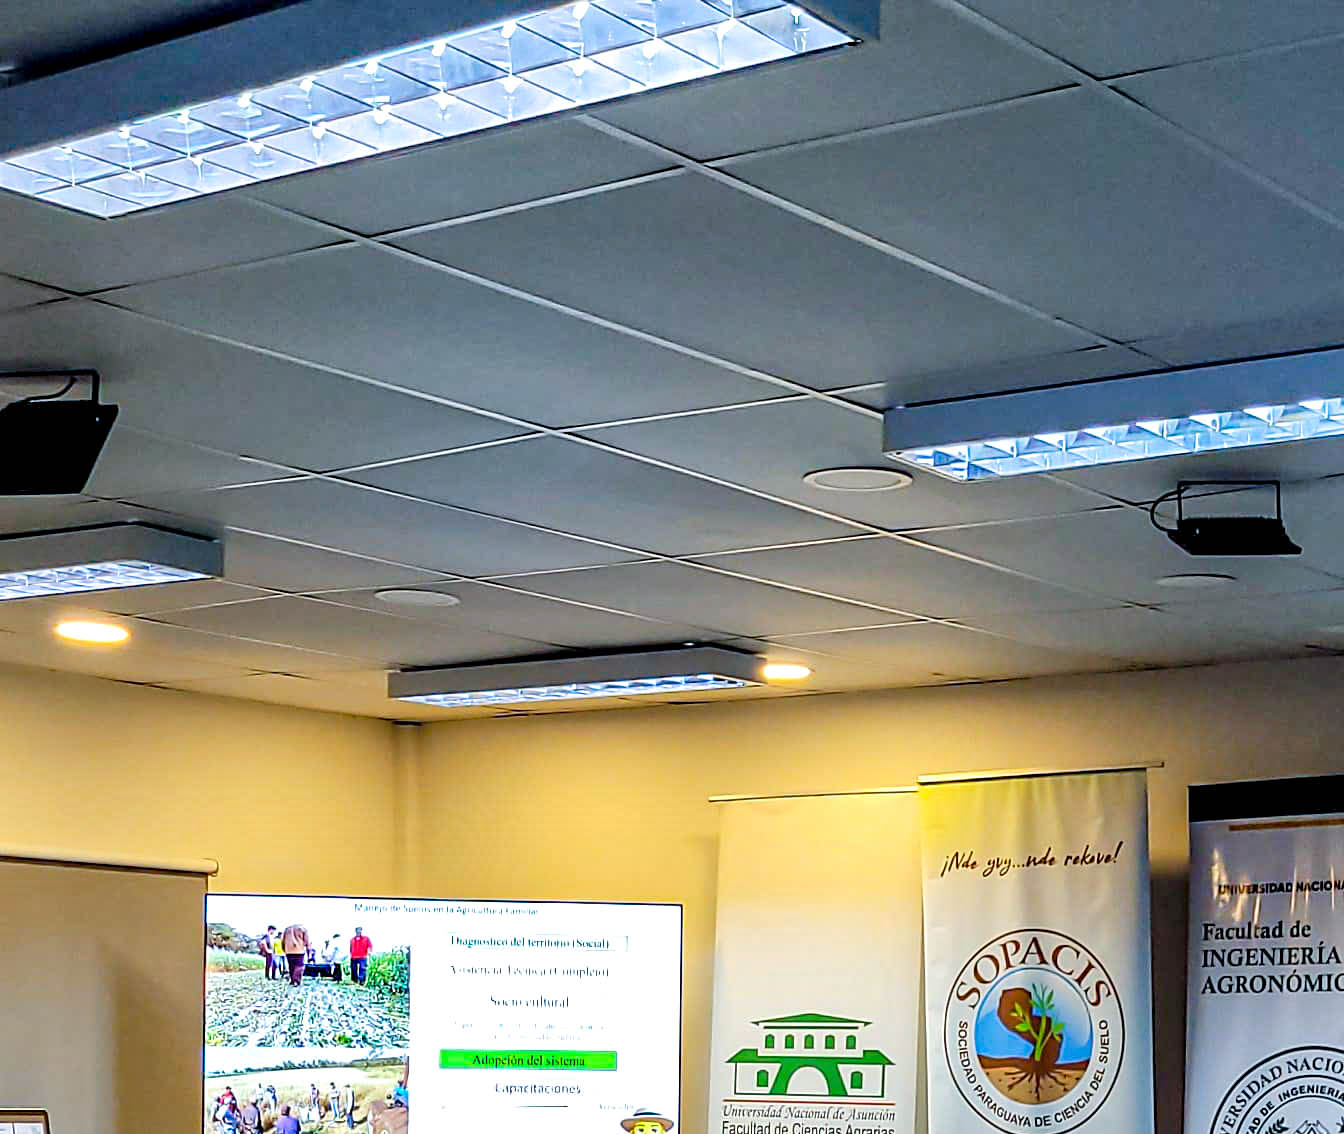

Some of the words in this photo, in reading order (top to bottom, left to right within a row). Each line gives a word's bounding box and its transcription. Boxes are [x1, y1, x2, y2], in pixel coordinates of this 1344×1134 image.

[1218, 882, 1293, 896] UNIVERSIDAD
[1202, 920, 1284, 941] Facultad
[1289, 920, 1311, 938] de
[1201, 941, 1342, 968] INGENIERÍA
[955, 936, 1112, 1009] SOPACIS
[472, 1054, 525, 1070] Adopción
[527, 1055, 544, 1067] del
[545, 1056, 585, 1067] sistema
[958, 1020, 977, 1085] SOCIEDAD
[973, 1084, 1031, 1128] PARAGUAYA
[1034, 1115, 1052, 1128] DE
[1054, 1089, 1094, 1123] CIENCIA
[1090, 1067, 1106, 1092] DEL
[1098, 1019, 1110, 1064] SUELO
[722, 1105, 783, 1118] Universidad
[784, 1106, 832, 1120] Nacional
[833, 1107, 845, 1120] de
[846, 1109, 896, 1122] Asunción
[1260, 1101, 1276, 1116] DE
